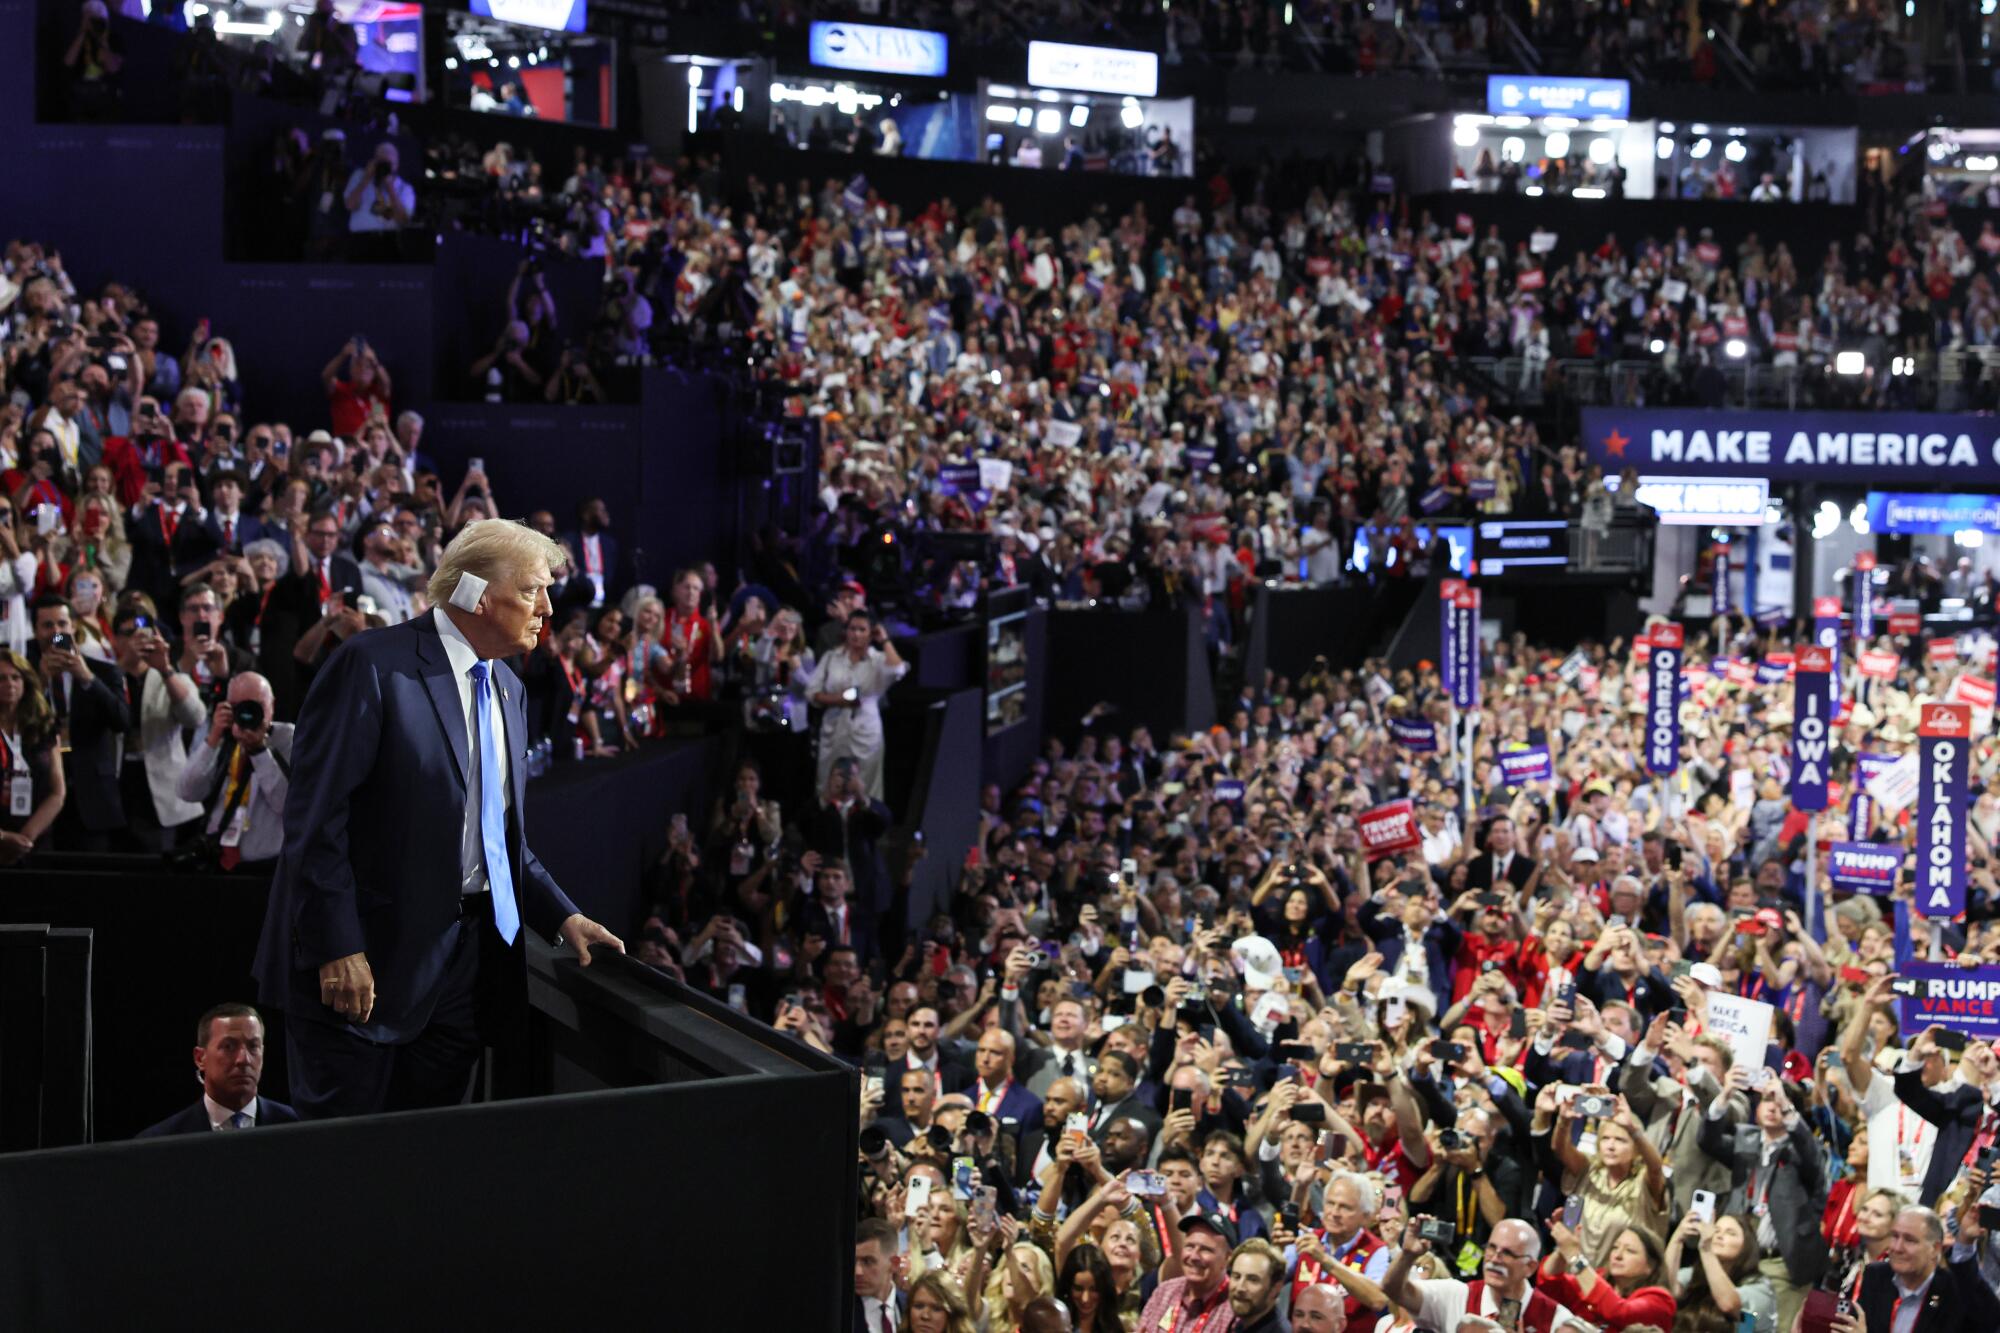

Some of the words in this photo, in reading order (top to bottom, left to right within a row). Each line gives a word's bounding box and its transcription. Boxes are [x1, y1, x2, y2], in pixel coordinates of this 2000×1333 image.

[1651, 430, 1771, 463] MAKE
[1785, 431, 1979, 467] AMERICA
[1652, 651, 1675, 766] OREGON
[1797, 694, 1826, 785] IOWA
[1501, 752, 1548, 769] TRUMP
[1362, 812, 1409, 835] TRUMP
[1928, 741, 1956, 908] OKLAHOMA
[1369, 827, 1408, 845] VANCE
[1834, 851, 1897, 870] TRUMP
[1927, 979, 2000, 1001] RUMP
[1921, 998, 1994, 1015] VANCE
